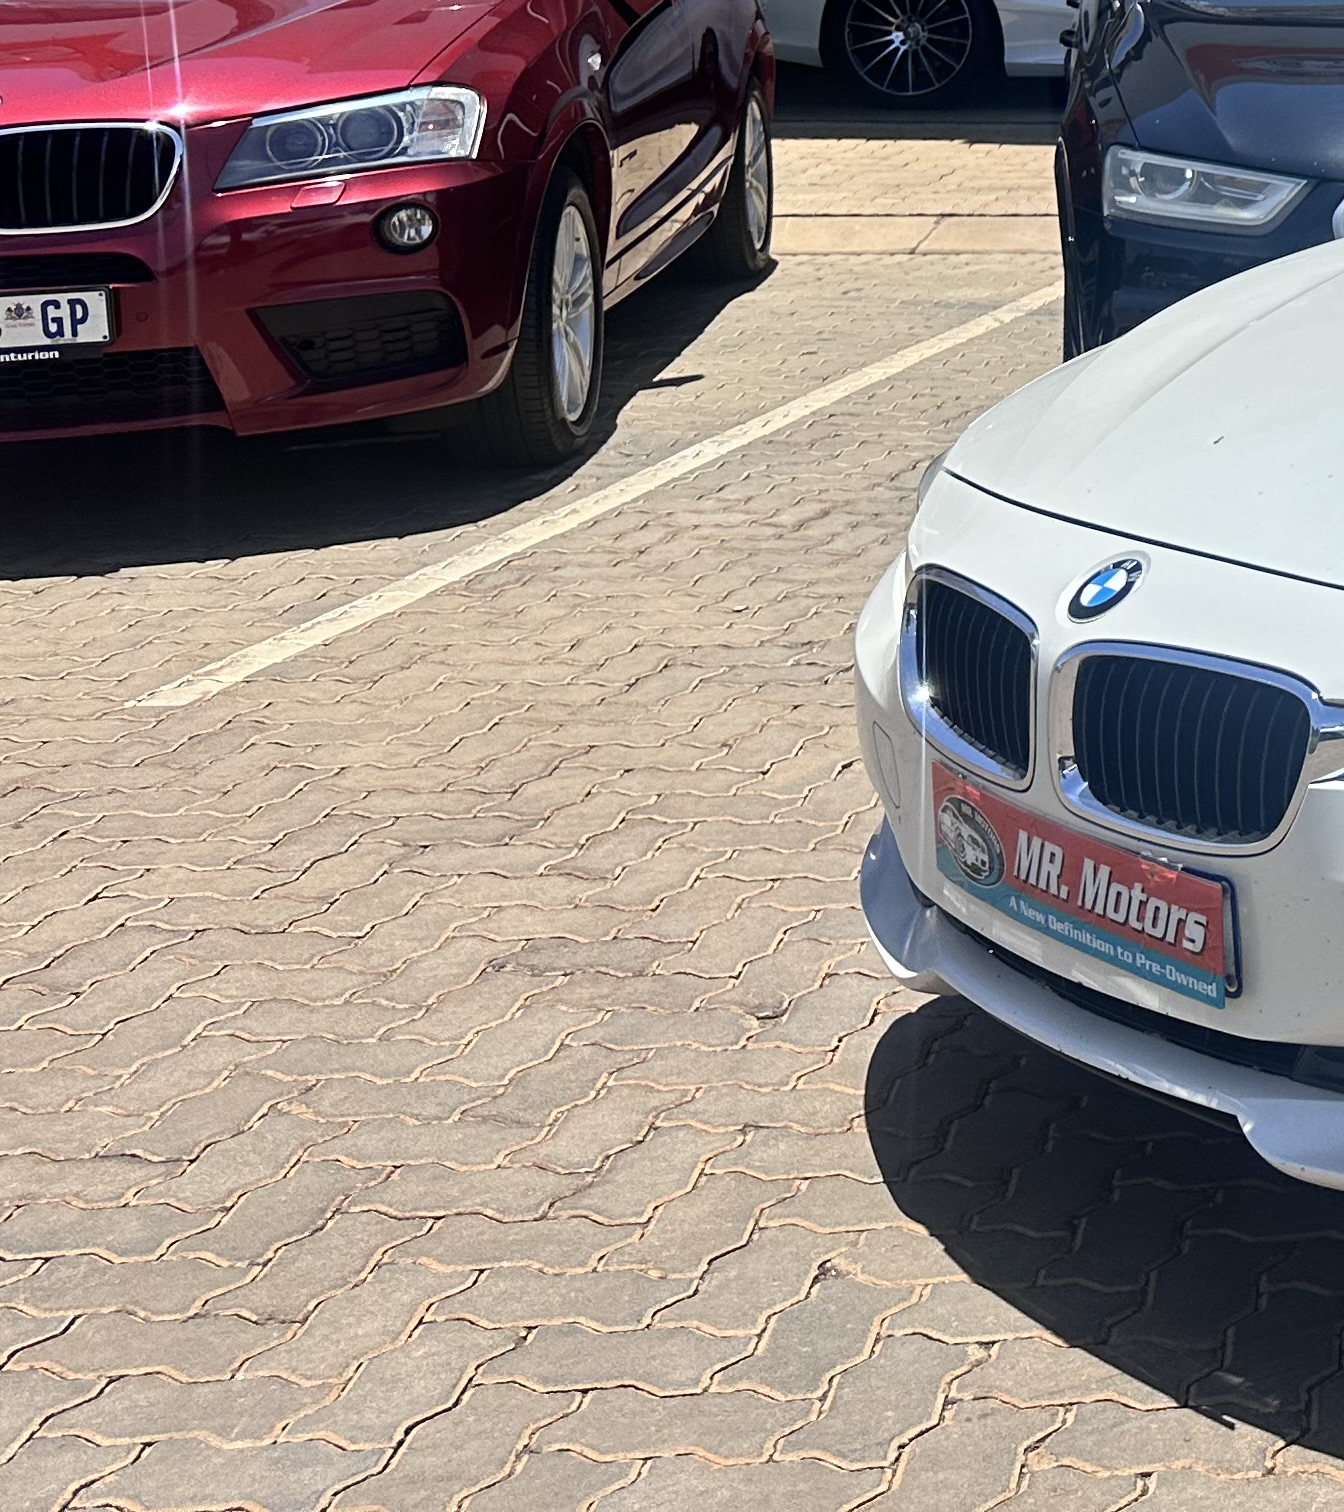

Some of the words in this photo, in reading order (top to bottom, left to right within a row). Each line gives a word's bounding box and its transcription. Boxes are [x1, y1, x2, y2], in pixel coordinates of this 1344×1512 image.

[40, 298, 89, 339] GP
[1013, 828, 1069, 901] MR.
[1077, 857, 1208, 954] Motors
[1009, 896, 1018, 911] A
[1020, 900, 1046, 925] New
[1048, 914, 1115, 955] Definition
[1117, 946, 1133, 963] to
[1136, 952, 1217, 998] Pre-Owned
